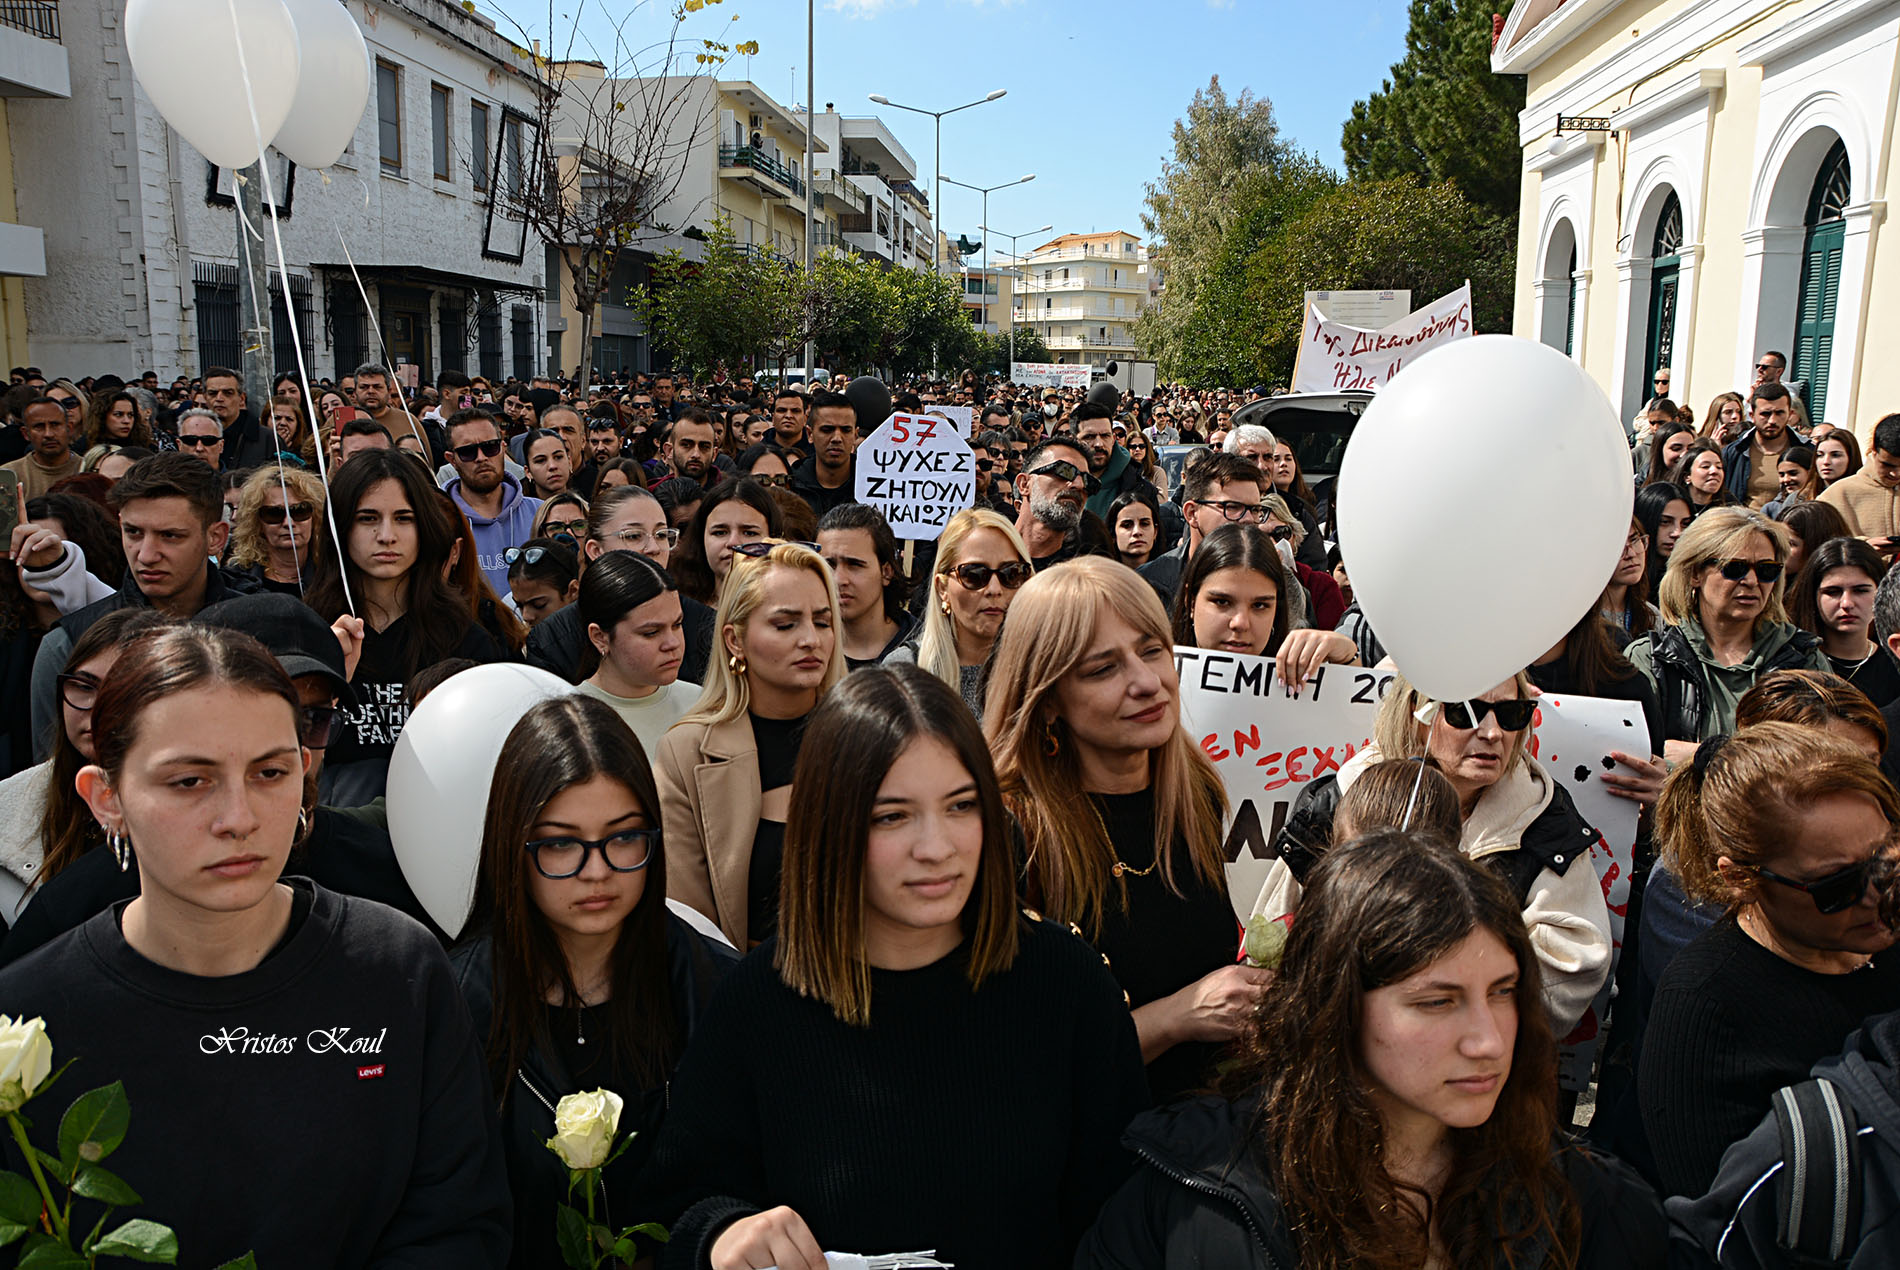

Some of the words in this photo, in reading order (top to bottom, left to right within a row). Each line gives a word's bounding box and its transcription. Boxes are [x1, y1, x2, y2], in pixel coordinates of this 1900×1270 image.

[891, 416, 937, 446] 57
[873, 449, 971, 473] ΨΥΧΕΣ
[866, 477, 971, 503] ΖΗΤΟΥΝ
[363, 683, 403, 703] THE
[1351, 674, 1395, 703] 20
[1200, 724, 1261, 762] ΕΝ
